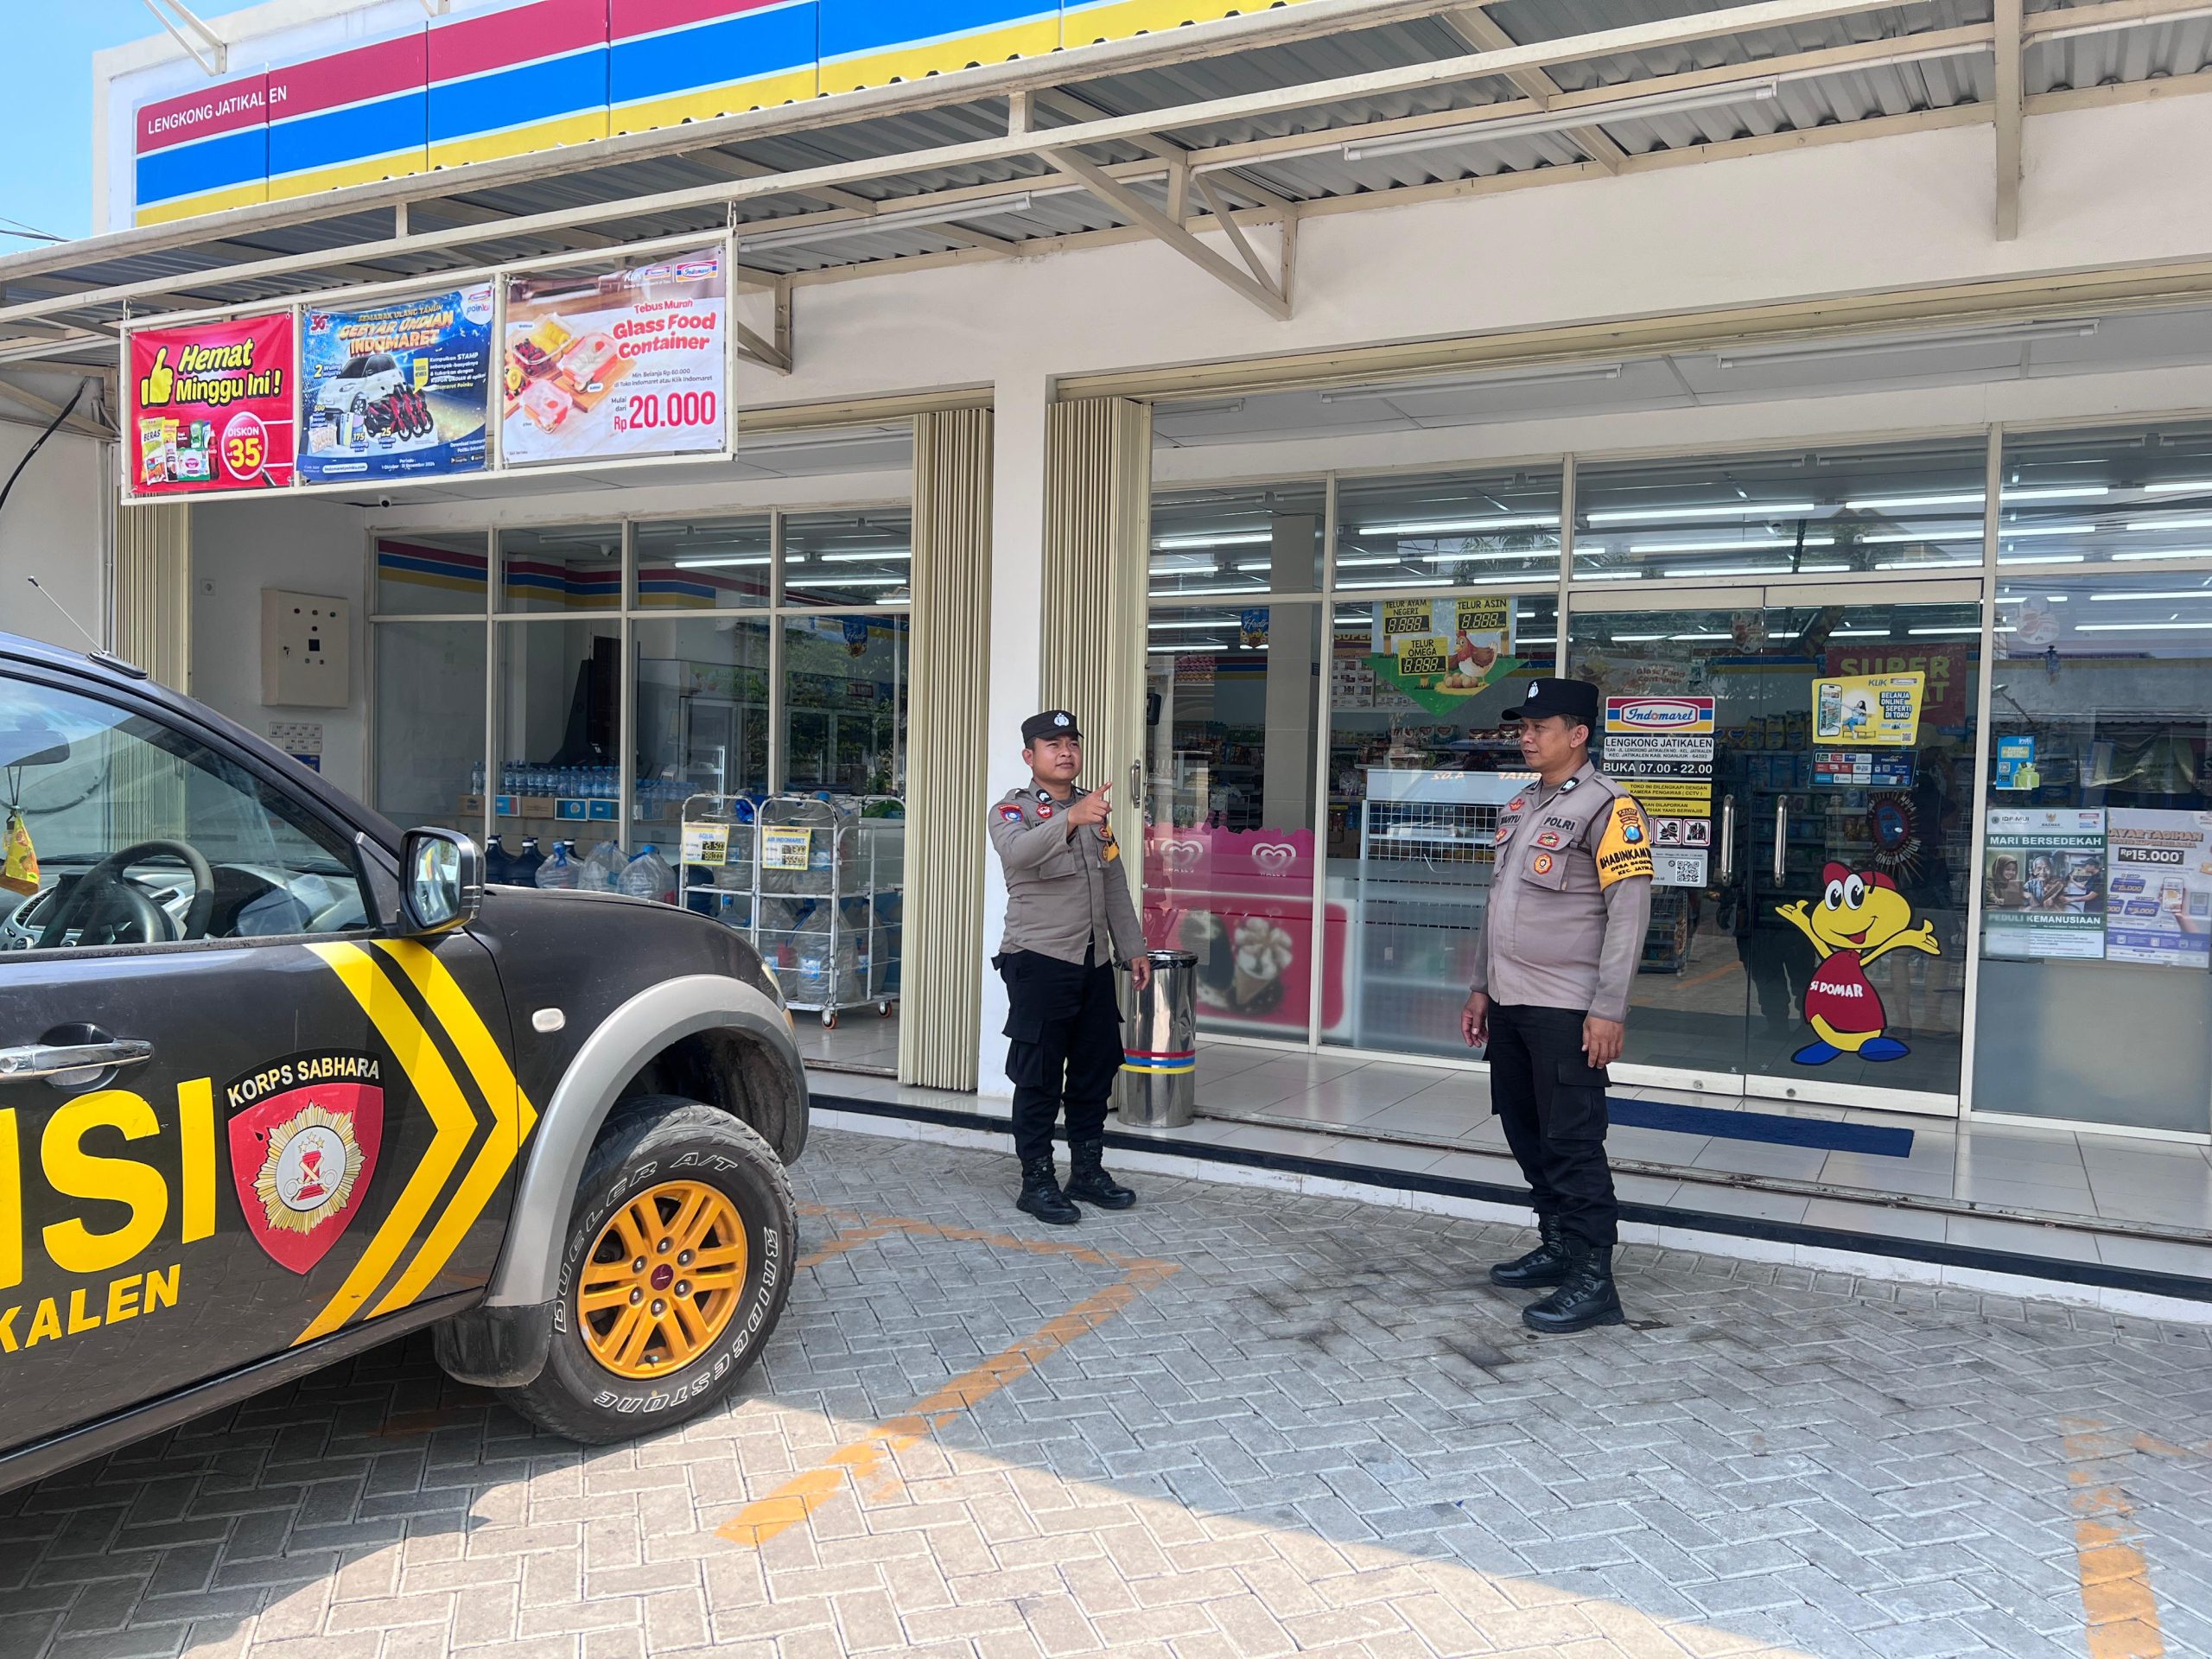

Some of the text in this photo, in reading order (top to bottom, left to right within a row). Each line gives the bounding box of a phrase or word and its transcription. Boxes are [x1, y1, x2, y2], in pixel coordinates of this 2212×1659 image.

[148, 105, 213, 135] LENGKONG
[634, 299, 693, 314] Tebus Murah
[339, 310, 454, 340] GEBYAR UNDIAN
[613, 311, 717, 340] Glass Food
[349, 329, 440, 358] INDOMARET
[618, 332, 710, 359] Container
[177, 338, 253, 373] Hemat
[456, 352, 479, 360] STAMP
[314, 364, 323, 378] 2
[176, 376, 245, 405] Minggu
[247, 374, 270, 397] Ini
[614, 391, 715, 433] Rp 20.000
[143, 429, 161, 442] BERAS
[227, 426, 259, 437] DISKON
[353, 433, 365, 442] 175
[381, 428, 391, 436] 25
[1407, 599, 1427, 607] AYAM
[1458, 599, 1507, 610] TELUR ASIN
[1393, 607, 1419, 616] NEGERI
[1411, 639, 1434, 648] TELUR
[1408, 648, 1437, 657] OMEGA
[1626, 709, 1694, 721] Indomaret
[1605, 738, 1713, 747] LENGKONG JATIKALEN
[1603, 763, 1713, 773] BUKA 07.00 22.00
[1544, 816, 1576, 831] POLRI
[2026, 915, 2101, 925] KEMANUSIAAN
[1819, 983, 1863, 997] DOMAR
[227, 1058, 379, 1108] KORPS SABHARA
[671, 1152, 739, 1173] A/T
[593, 1226, 778, 1414] BRIDGESTONE
